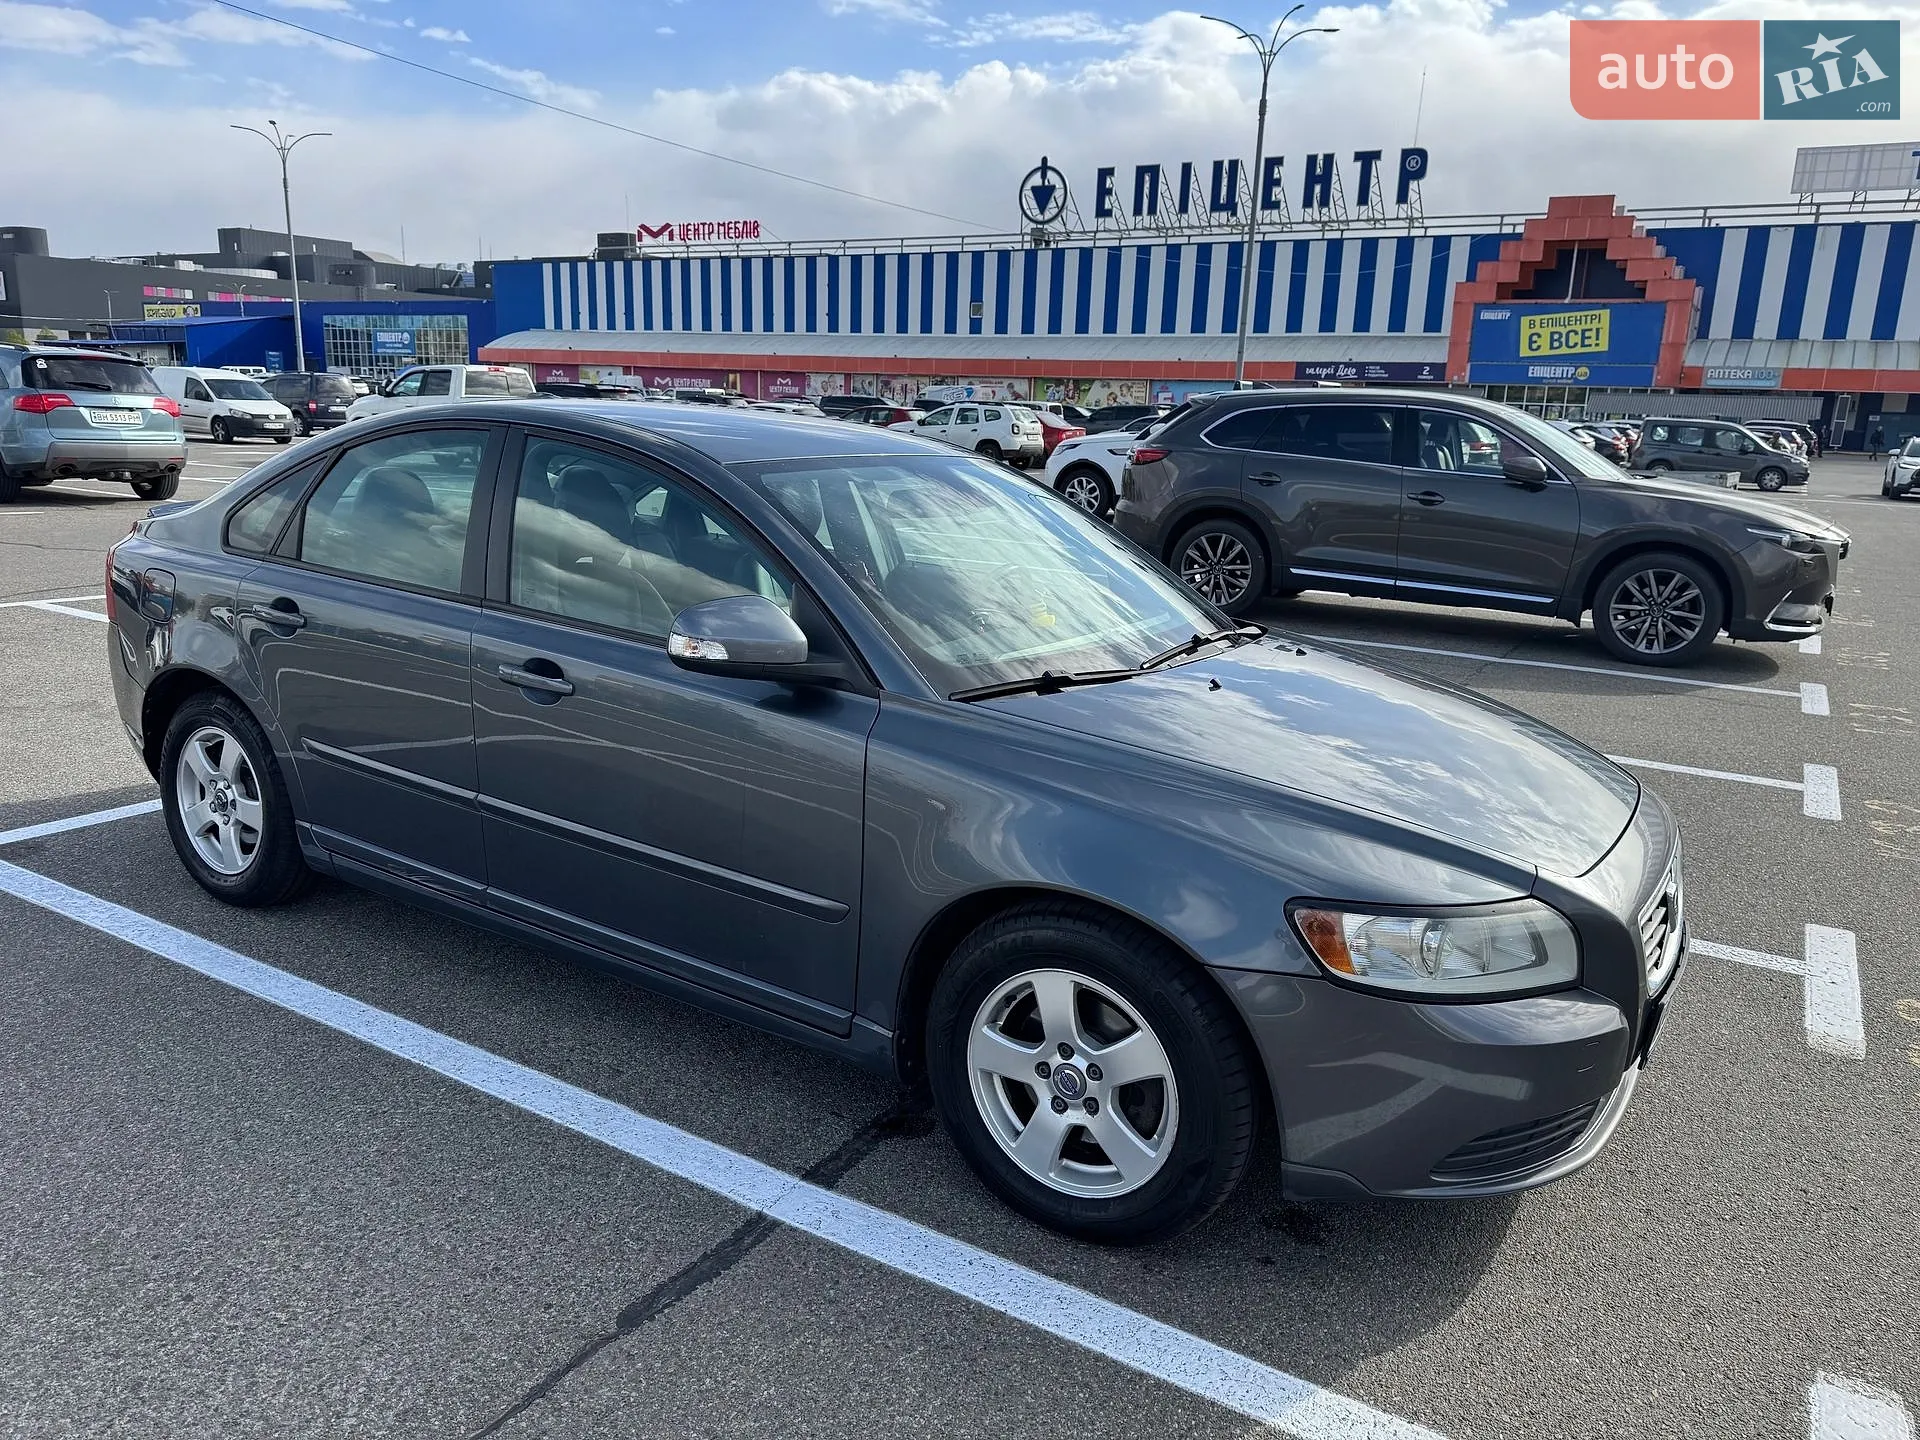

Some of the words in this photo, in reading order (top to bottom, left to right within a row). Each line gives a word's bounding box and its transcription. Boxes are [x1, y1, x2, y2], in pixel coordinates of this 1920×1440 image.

[1094, 147, 1428, 219] ЕПІЦЕНТР
[678, 221, 714, 242] ЦЕНТР
[717, 220, 760, 240] МЕБЛІВ
[1528, 319, 1536, 329] В
[1539, 313, 1601, 329] ЕПІЦЕНТРІ
[1528, 332, 1542, 352] Є
[1549, 327, 1601, 351] ВСЕ!
[1422, 366, 1430, 375] 2
[1707, 368, 1752, 379] АПТЕКА
